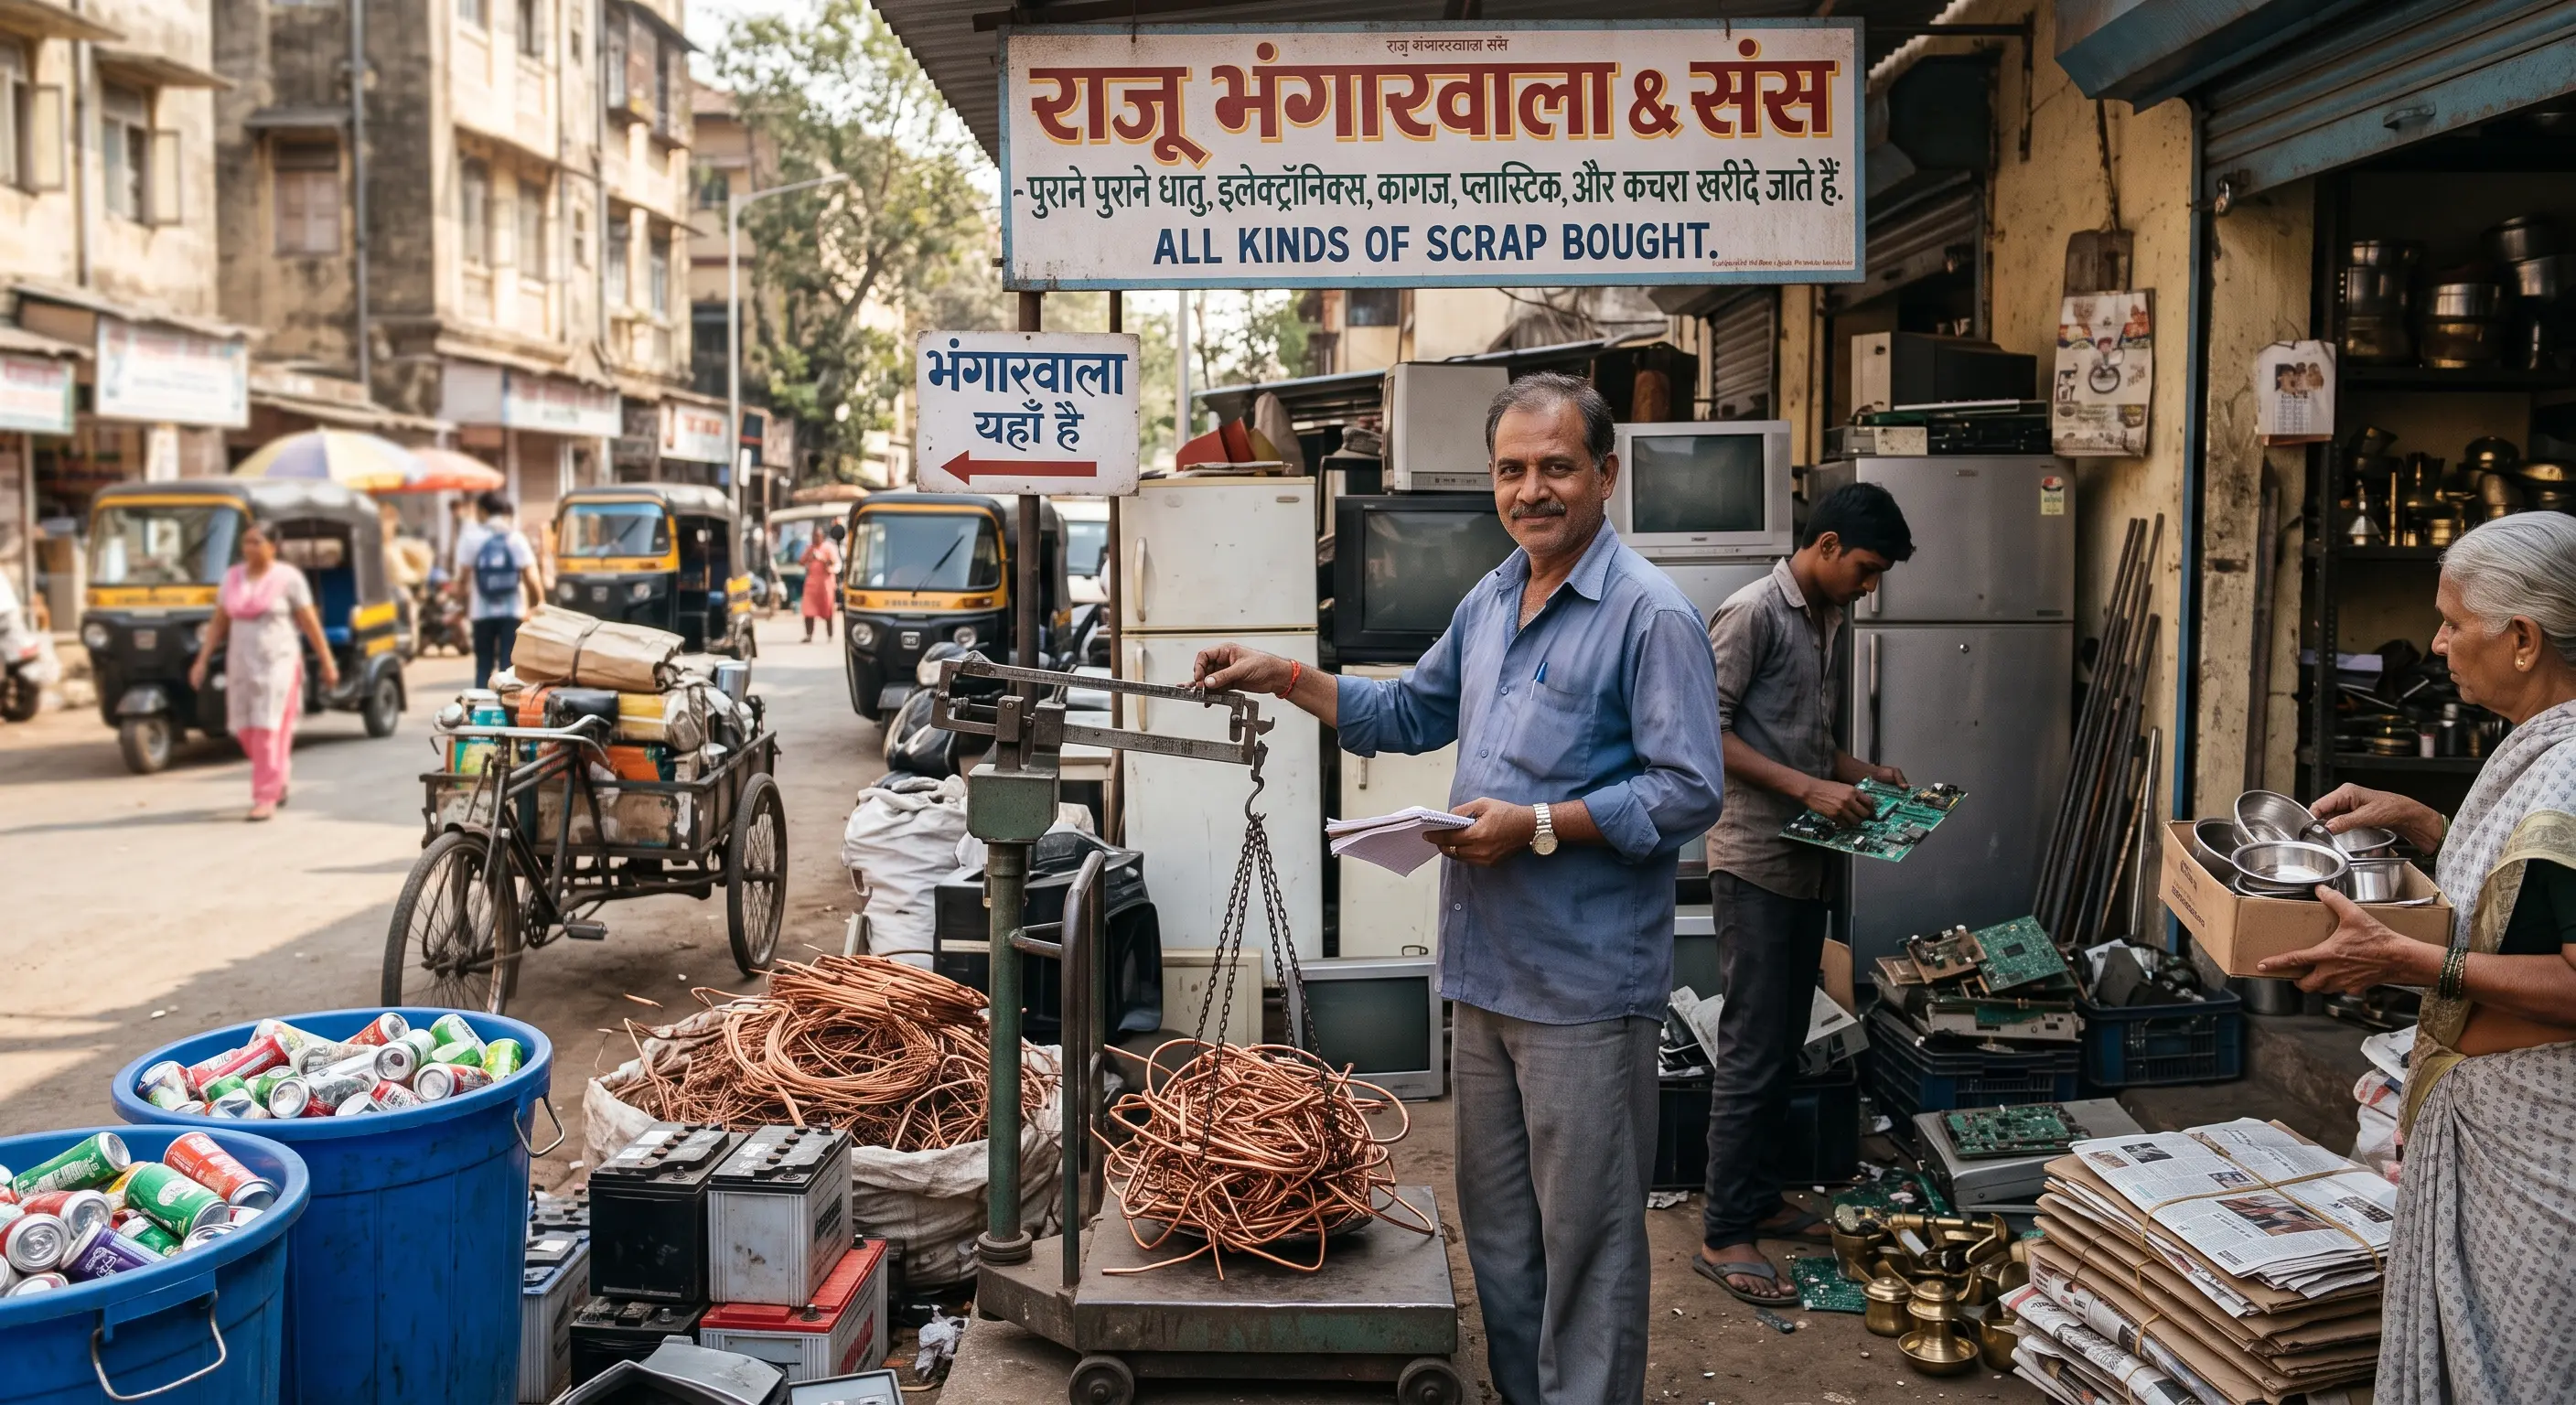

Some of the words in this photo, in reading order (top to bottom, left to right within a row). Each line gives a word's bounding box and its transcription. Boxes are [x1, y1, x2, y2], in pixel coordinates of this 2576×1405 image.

[1029, 67, 1213, 170] राजू
[1211, 42, 1621, 143] भंगारवाला
[1628, 70, 1684, 140] &
[1690, 38, 1841, 139] संस
[1092, 165, 1151, 219] पुराने
[1159, 174, 1213, 217] धातु,
[1378, 173, 1457, 209] कागज,
[1460, 161, 1567, 208] प्लास्टिक,
[1572, 159, 1616, 202] और
[1623, 171, 1689, 203] कचरा
[1696, 159, 1760, 205] खरीदे
[1765, 158, 1815, 201] जाते
[1154, 228, 1223, 264] ALL
[1240, 226, 1350, 263] KINDS
[1365, 225, 1410, 263] OF
[1426, 223, 1547, 263] SCRAP
[1562, 221, 1719, 261] BOUGHT.
[927, 338, 1129, 397] भंगारवाला
[973, 399, 1045, 451] यहाँ
[1055, 401, 1085, 452] है
